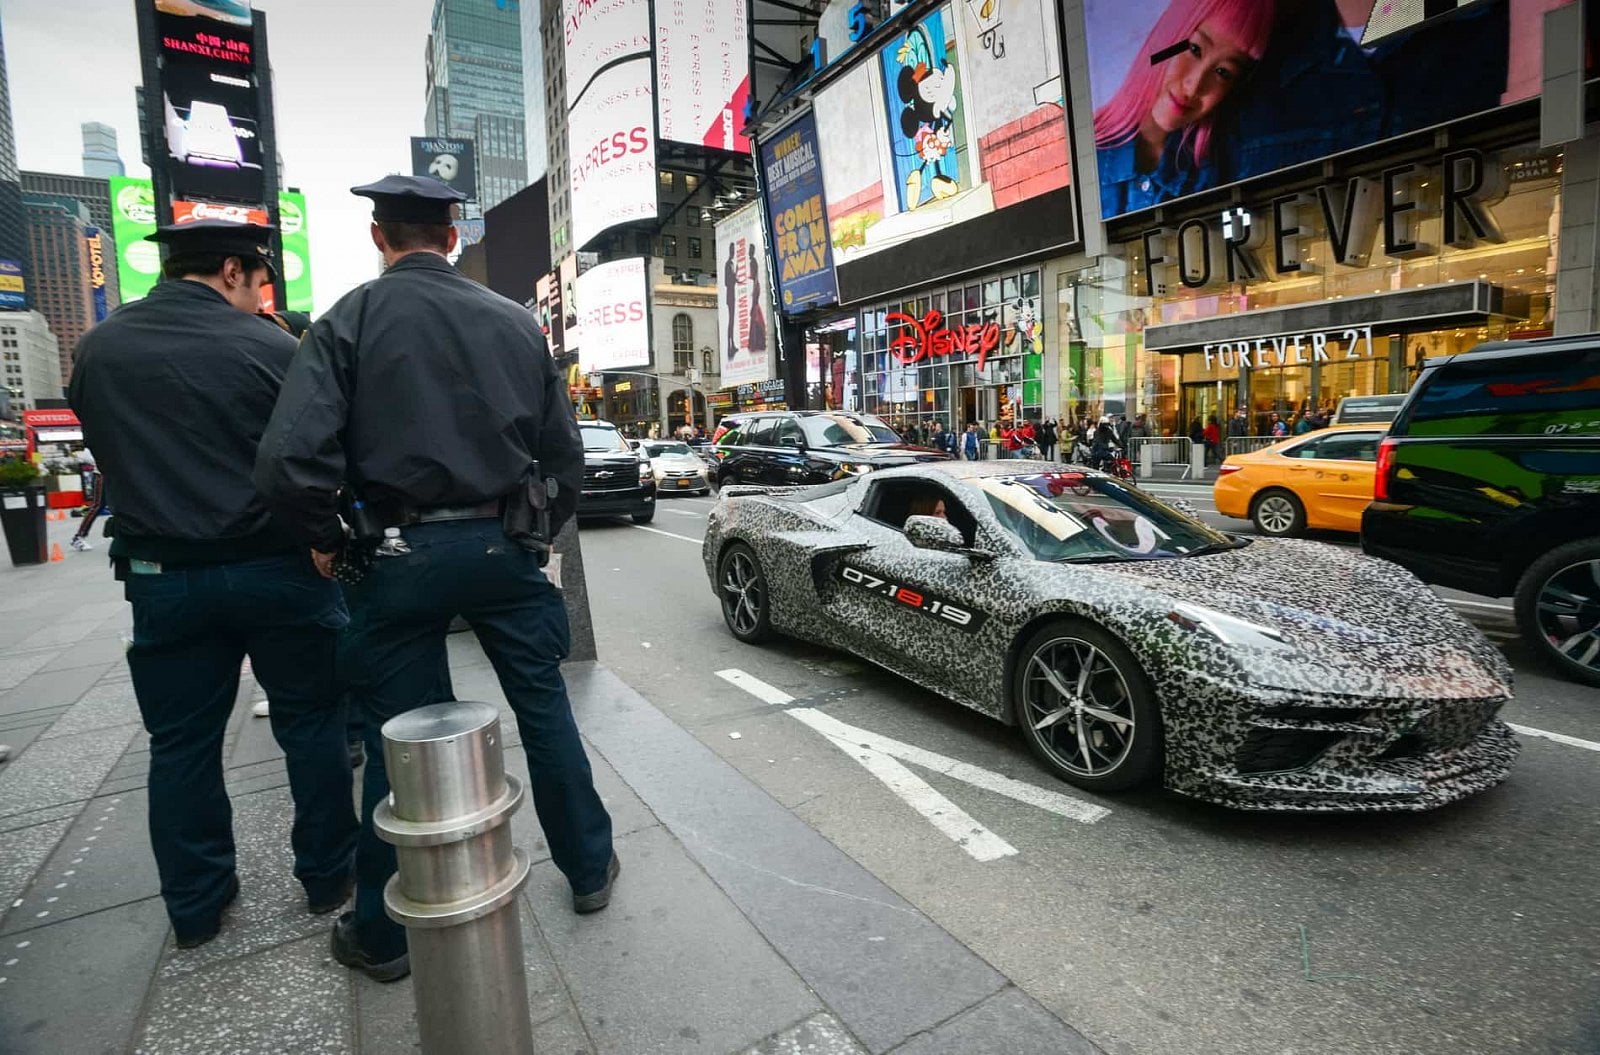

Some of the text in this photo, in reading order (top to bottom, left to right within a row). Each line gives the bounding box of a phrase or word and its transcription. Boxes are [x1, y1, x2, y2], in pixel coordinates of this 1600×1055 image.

[573, 127, 649, 192] EXPRESS
[768, 141, 815, 184] BEST MUSICAL
[775, 194, 823, 236] COME
[1141, 147, 1504, 297] FOREVER
[777, 219, 827, 259] FROM
[782, 242, 828, 282] AWAY
[1203, 327, 1374, 370] FOREVER 21
[842, 567, 972, 625] 07.18.19
